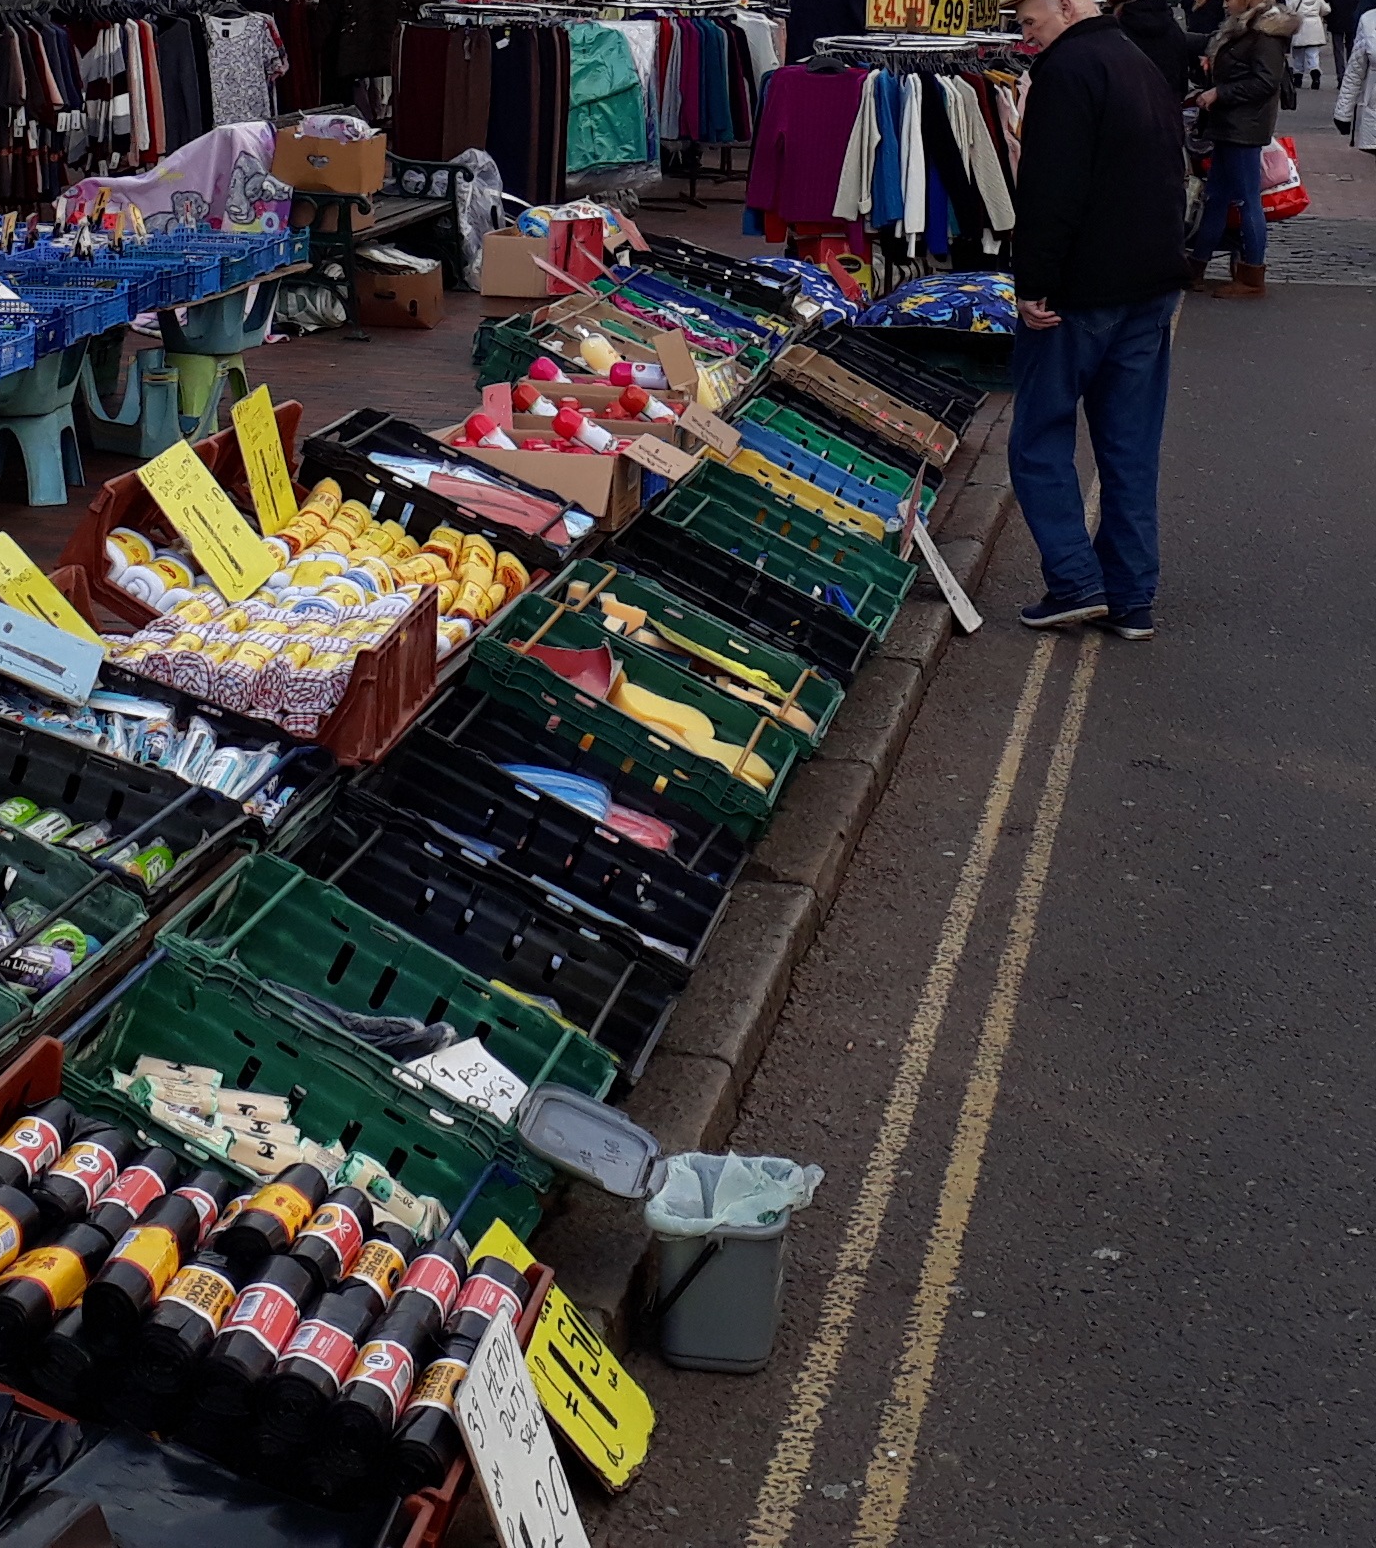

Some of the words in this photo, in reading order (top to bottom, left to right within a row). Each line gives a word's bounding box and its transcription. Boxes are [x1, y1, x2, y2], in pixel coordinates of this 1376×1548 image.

[11, 958, 45, 976] Liners
[459, 1060, 490, 1087] POO
[365, 1247, 389, 1279] REFUSE
[183, 1272, 205, 1304] SACKS
[197, 1279, 223, 1312] REFUSE
[480, 1320, 518, 1409] HEAVY
[499, 1378, 528, 1440] DUTY
